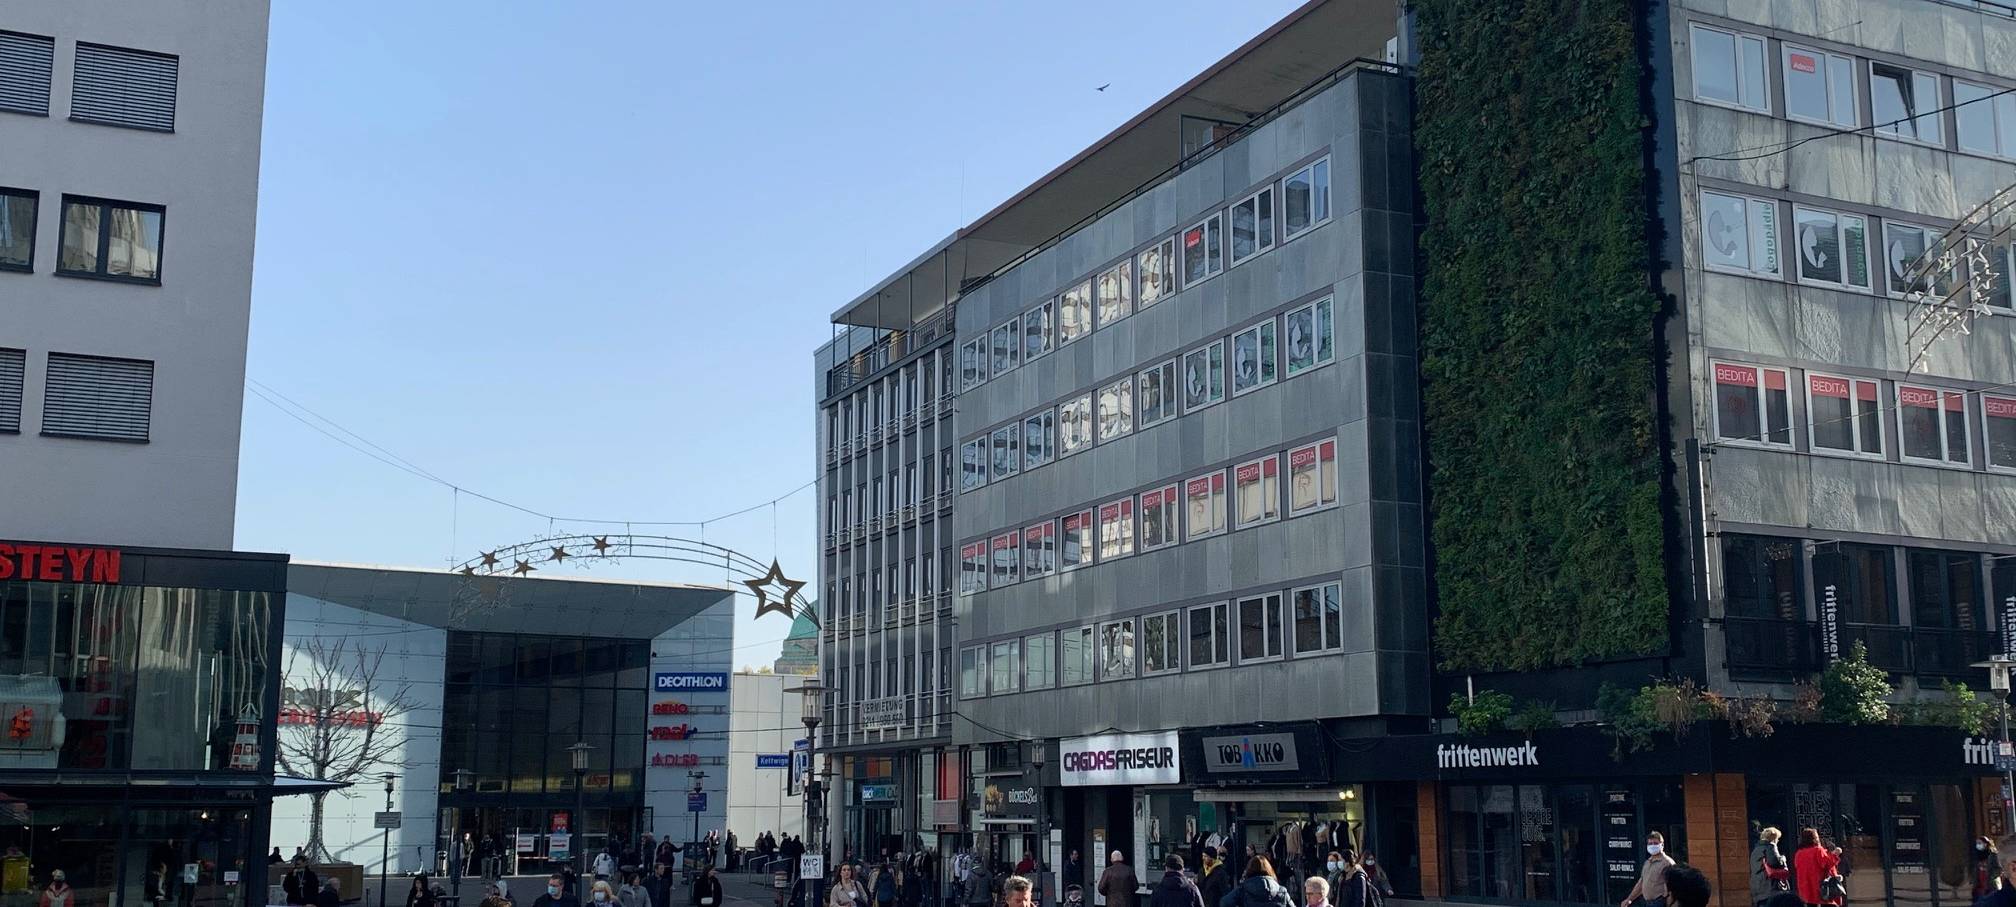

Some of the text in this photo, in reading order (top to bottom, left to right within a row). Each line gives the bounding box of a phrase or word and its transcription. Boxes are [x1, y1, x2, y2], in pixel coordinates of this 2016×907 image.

[1717, 368, 1755, 384] BEDITA
[1811, 379, 1848, 395] BEDITA
[1901, 390, 1937, 406] BEDITA
[1292, 450, 1315, 465] BEDITA
[1238, 466, 1259, 481] BEDITA
[1189, 482, 1208, 494] BEDITA
[1143, 494, 1161, 507] BEDITA
[658, 676, 723, 688] DECATHLON
[653, 703, 690, 715] RENO
[1437, 740, 1539, 769] frittenwerk
[802, 858, 818, 867] WC
